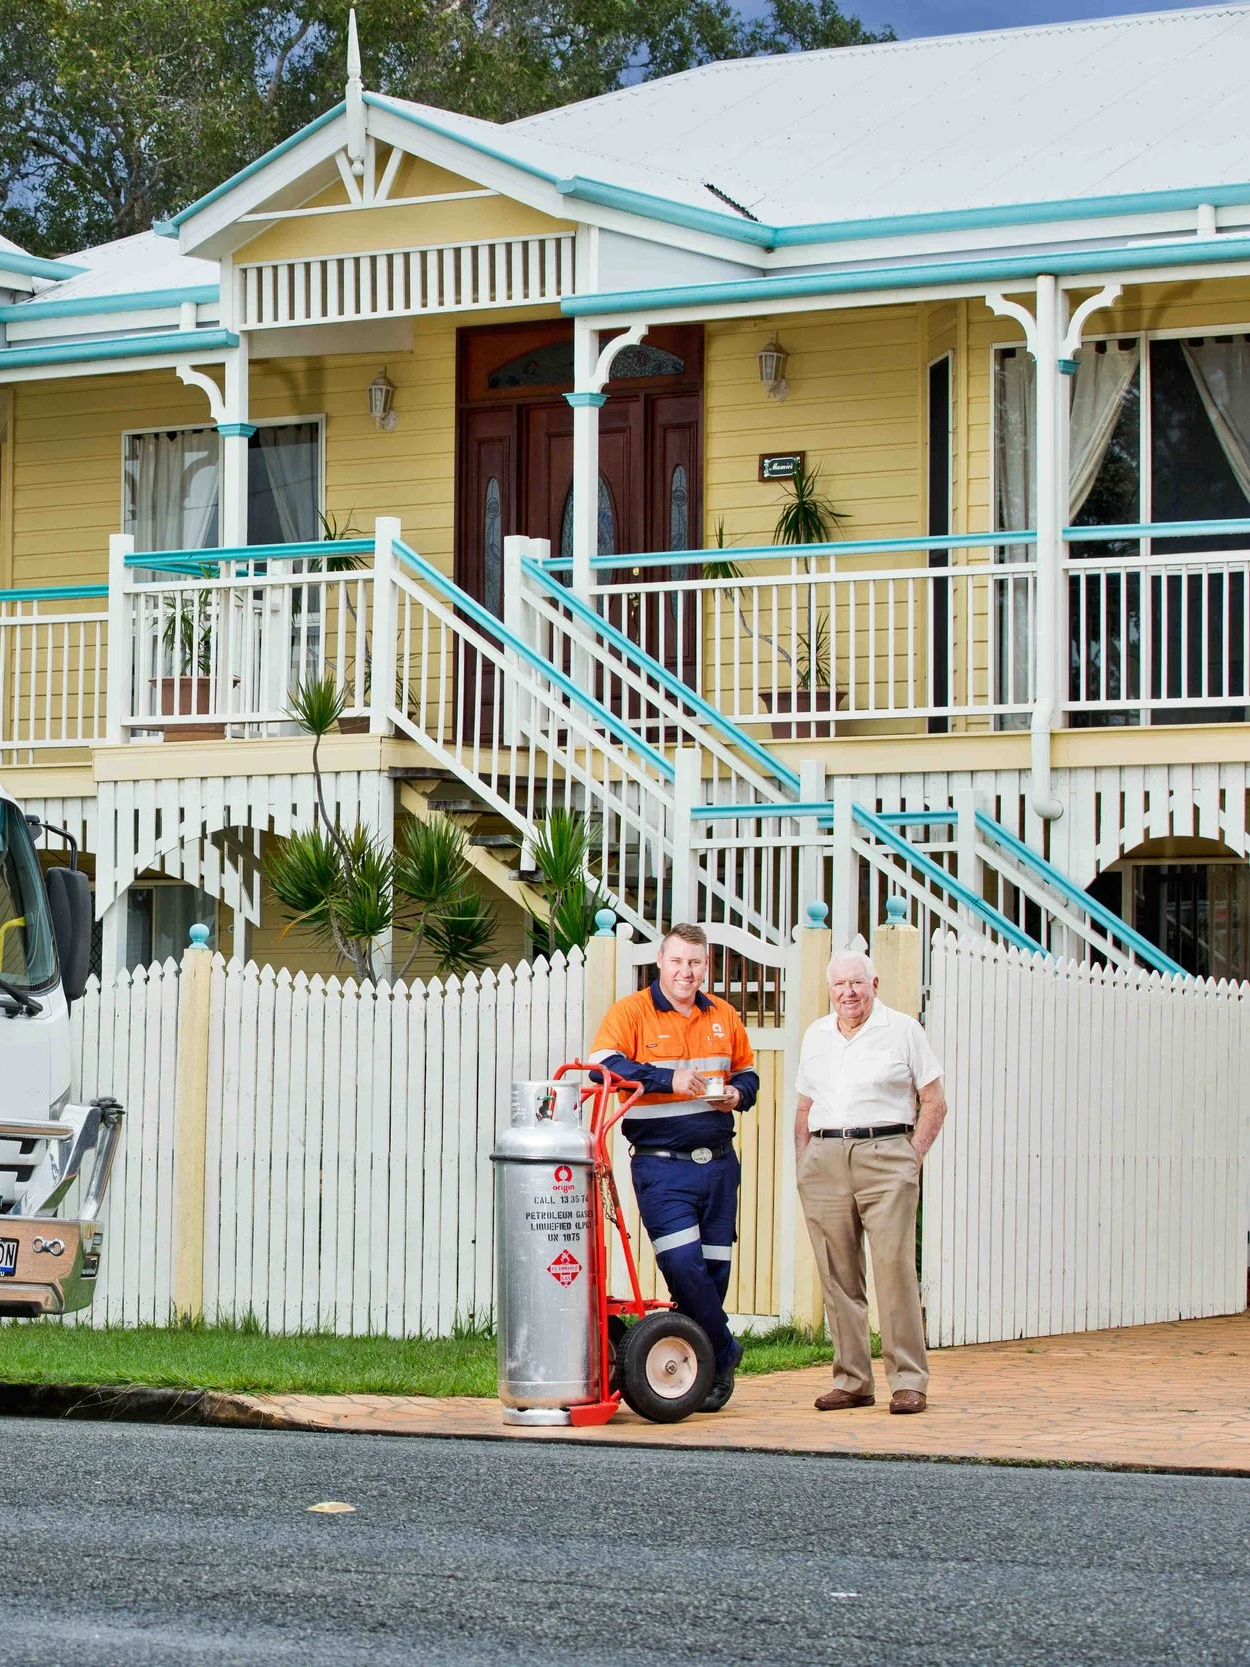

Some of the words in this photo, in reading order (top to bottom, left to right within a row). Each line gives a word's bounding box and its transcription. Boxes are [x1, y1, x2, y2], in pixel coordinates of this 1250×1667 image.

[552, 1185, 575, 1194] origin
[534, 1196, 555, 1204] CALL
[561, 1195, 569, 1204] 13
[571, 1195, 580, 1203] 35
[526, 1211, 573, 1220] PETROLEUM
[531, 1222, 572, 1231] LIQUEFIED
[548, 1234, 559, 1242] UN
[563, 1233, 580, 1242] 1075
